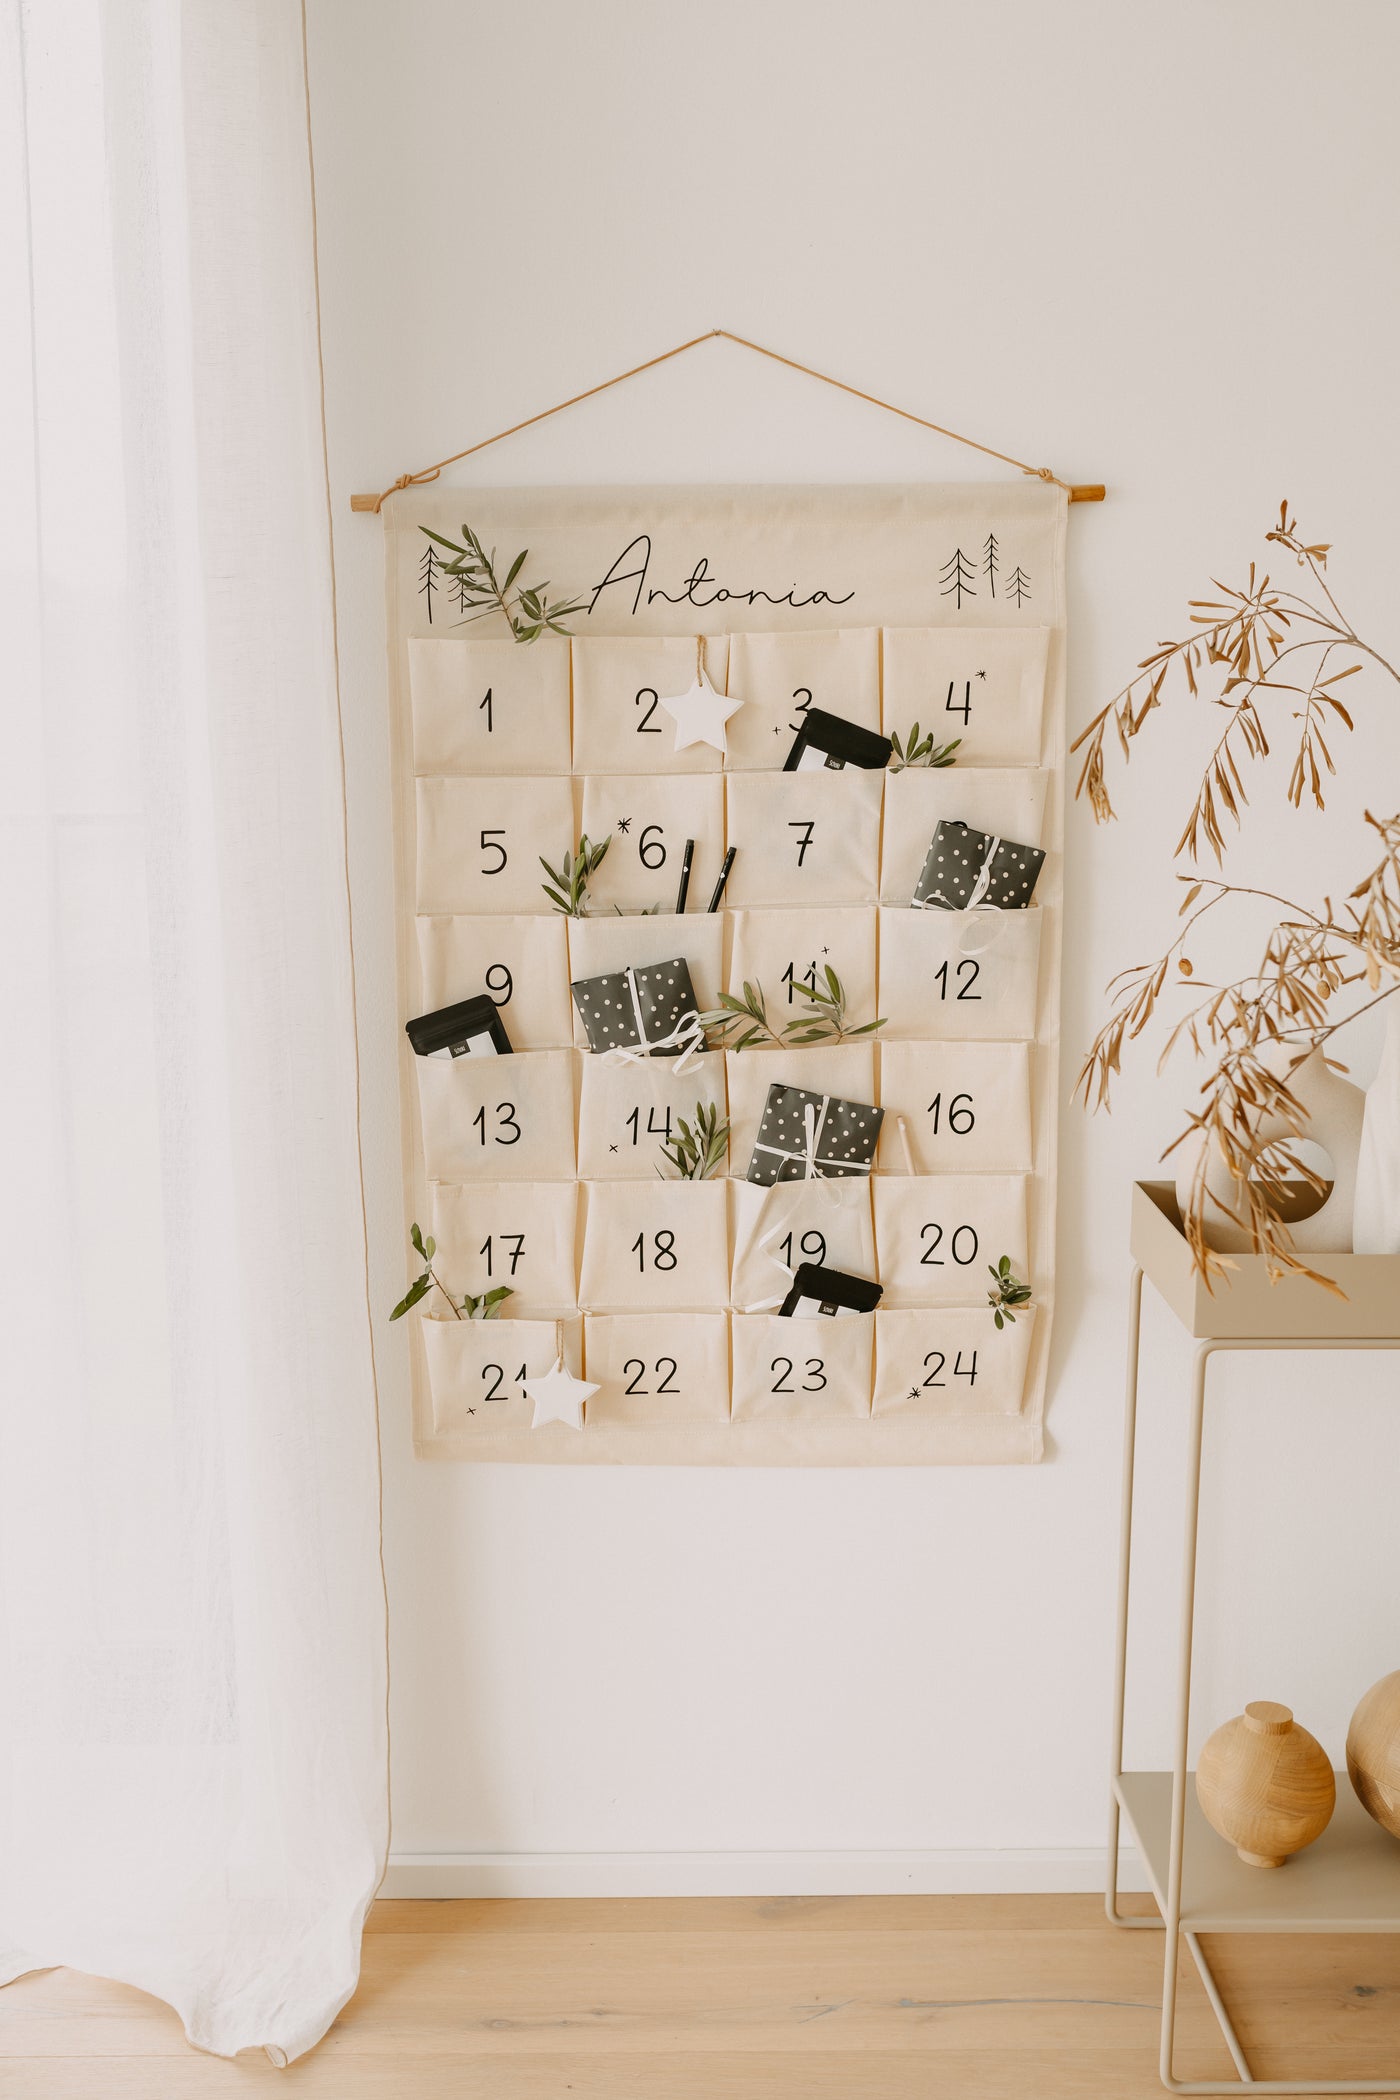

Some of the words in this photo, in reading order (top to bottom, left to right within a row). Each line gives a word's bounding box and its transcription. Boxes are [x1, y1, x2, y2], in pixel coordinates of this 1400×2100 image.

[588, 535, 855, 615] Antonia
[480, 688, 493, 732] 1
[636, 688, 662, 733] 2
[788, 687, 813, 731] 3
[945, 681, 972, 726] 4
[481, 830, 507, 875] 5
[639, 825, 667, 870] 6
[788, 821, 815, 867] 7
[485, 964, 514, 1007] 9
[781, 960, 816, 1005] 11
[934, 960, 982, 1001] 12
[473, 1103, 521, 1145] 13
[626, 1106, 673, 1146] 14
[928, 1093, 975, 1135] 16
[480, 1234, 526, 1277] 17
[632, 1229, 677, 1273] 18
[779, 1230, 827, 1269] 19
[919, 1223, 979, 1266] 20
[481, 1363, 527, 1402] 21
[623, 1358, 681, 1396] 22
[770, 1358, 828, 1394] 23
[922, 1351, 979, 1386] 24
